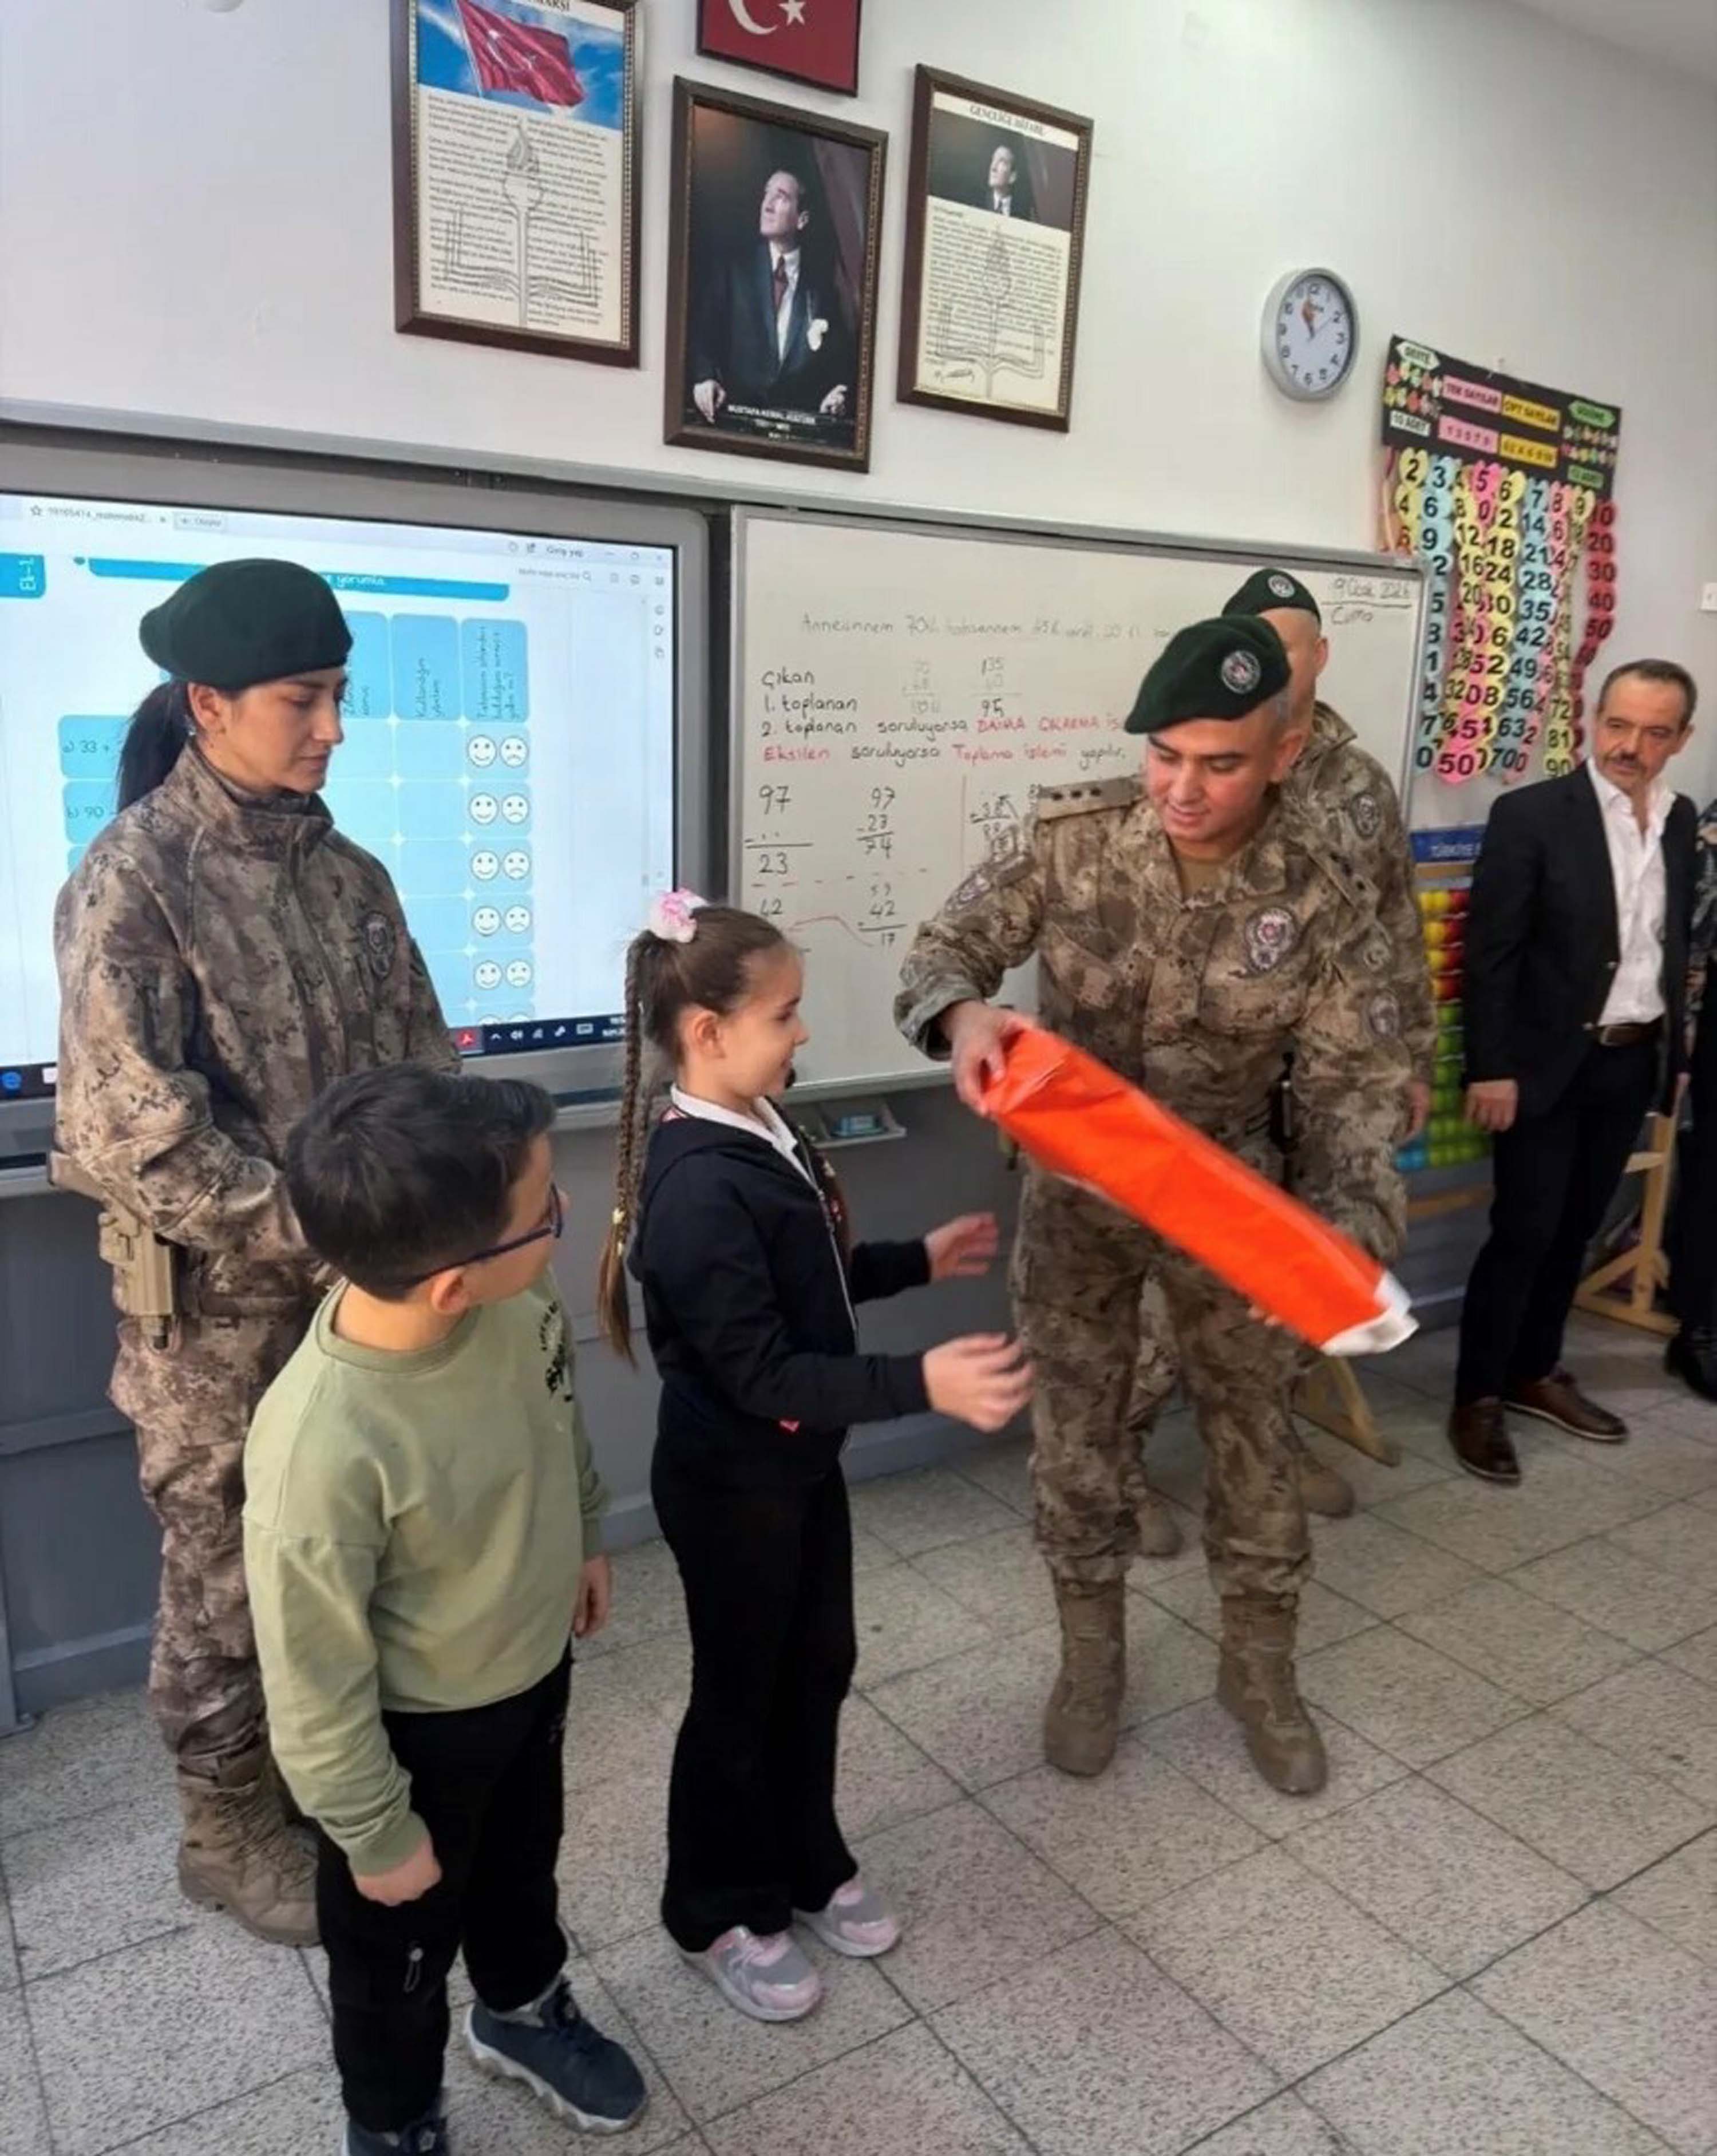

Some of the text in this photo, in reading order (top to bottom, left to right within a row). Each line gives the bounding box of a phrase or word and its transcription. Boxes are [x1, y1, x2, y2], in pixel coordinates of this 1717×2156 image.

[1406, 458, 1419, 481] 2
[1433, 465, 1446, 489] 3
[1476, 469, 1489, 492] 5
[1500, 480, 1512, 501] 6
[1532, 489, 1543, 509] 7
[1399, 495, 1409, 514] 4
[1424, 497, 1438, 517] 6
[1552, 493, 1563, 513] 8
[1457, 523, 1479, 545] 12
[1523, 513, 1545, 535] 14
[1422, 528, 1438, 550] 9
[1488, 536, 1516, 559] 18
[1588, 532, 1613, 553] 20
[1524, 543, 1548, 563] 21
[1462, 553, 1483, 576] 16
[1486, 561, 1512, 583] 24
[1524, 571, 1552, 591] 28
[1520, 600, 1552, 622] 35
[1516, 627, 1545, 647] 42
[1586, 618, 1613, 640] 50
[761, 666, 814, 690] Çıkan
[1510, 658, 1537, 679] 49
[782, 692, 858, 720] toplanan
[981, 698, 1005, 718] 95
[1506, 688, 1533, 709] 56
[785, 717, 858, 741] toplanan
[877, 717, 968, 742] soruluyorsa
[1498, 718, 1525, 737] 63
[1548, 729, 1570, 748] 81
[80, 739, 97, 753] 33
[763, 745, 830, 762] Eksilen
[850, 741, 941, 768] soruluyorsa
[951, 743, 1014, 768] Toplama
[1438, 753, 1475, 776] 50
[758, 784, 792, 816] 97
[871, 786, 896, 810] 97
[84, 805, 105, 819] 90
[868, 813, 888, 832] 23
[758, 852, 789, 876] 23
